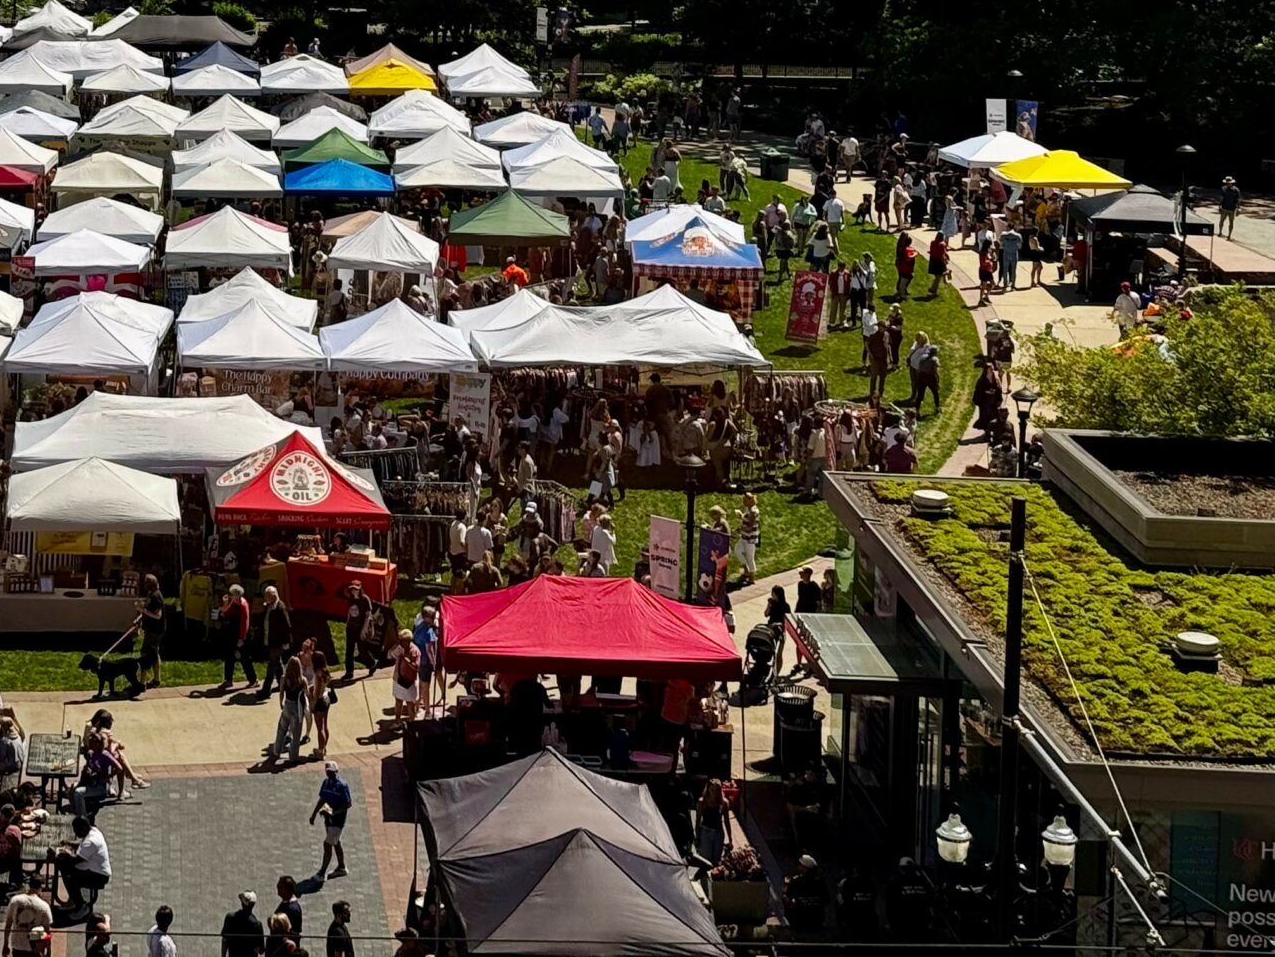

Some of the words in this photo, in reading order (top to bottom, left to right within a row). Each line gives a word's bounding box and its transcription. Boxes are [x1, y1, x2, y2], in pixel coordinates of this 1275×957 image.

[223, 369, 242, 381] The
[244, 371, 273, 384] Happy
[221, 381, 255, 394] Charm
[256, 384, 273, 395] Bar
[276, 454, 326, 480] MIDNIGHT
[291, 492, 313, 501] OIL
[1229, 883, 1275, 903] New
